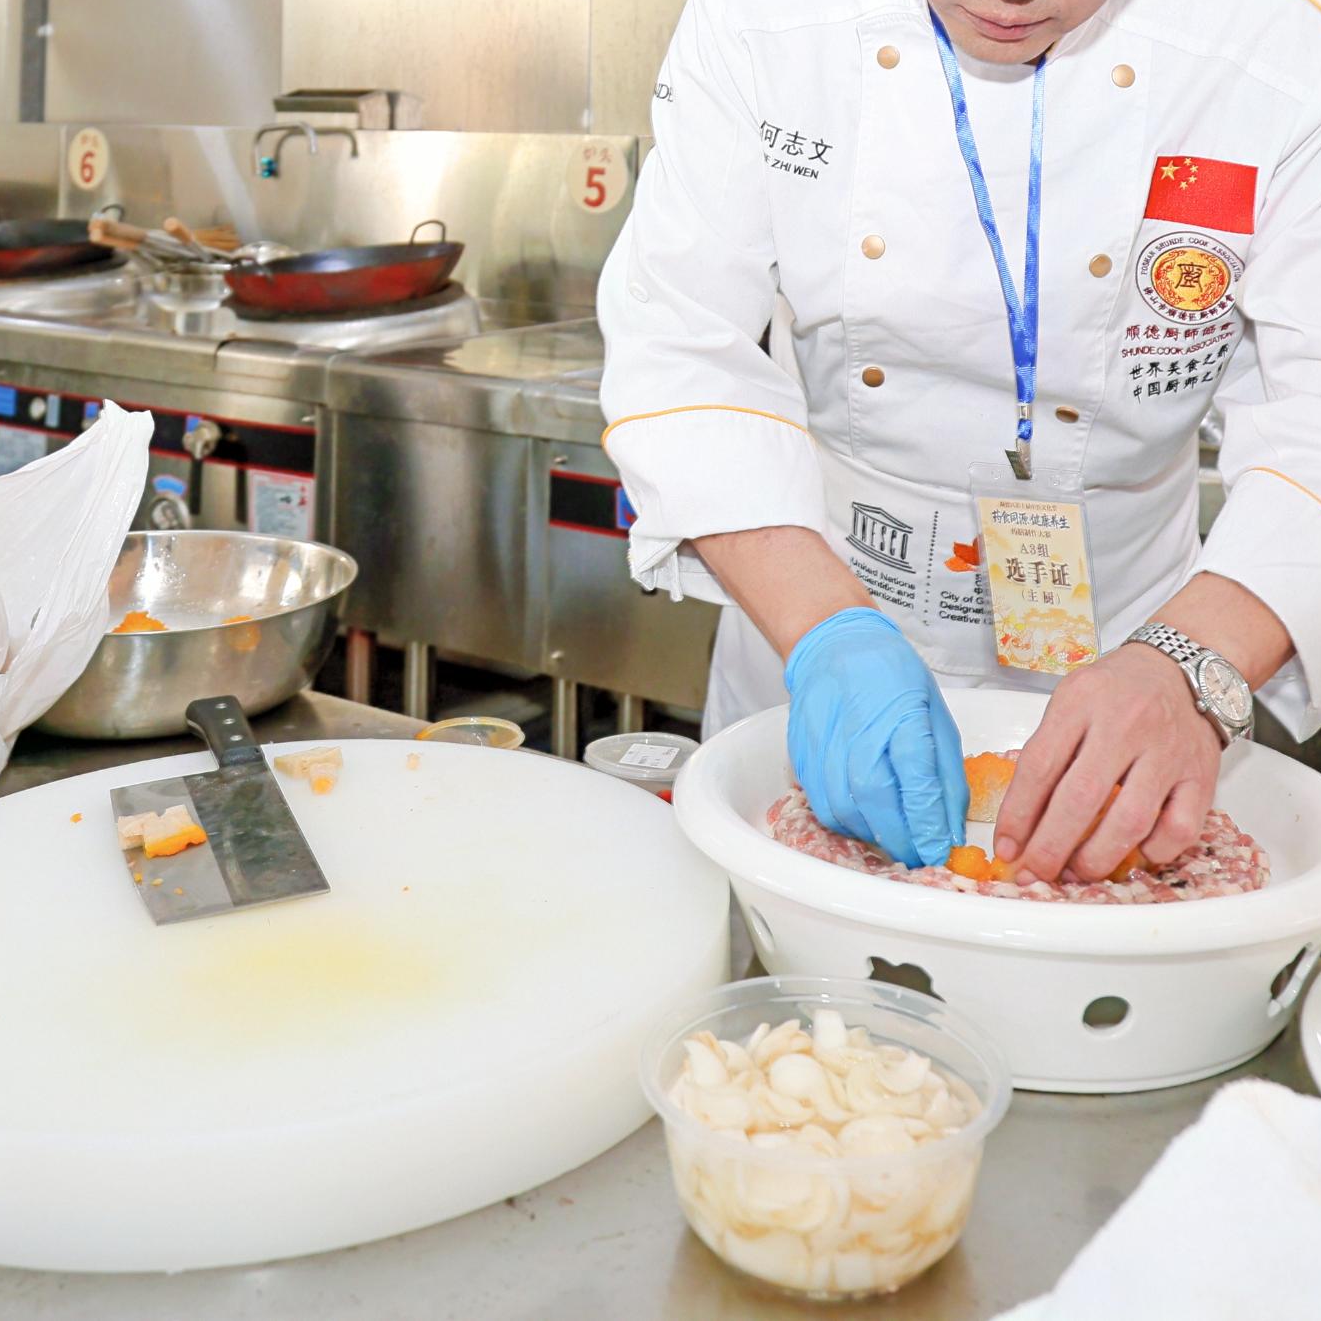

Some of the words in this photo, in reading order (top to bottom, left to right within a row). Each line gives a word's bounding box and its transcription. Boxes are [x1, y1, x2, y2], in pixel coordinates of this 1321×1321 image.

[760, 120, 833, 165] 何志文
[80, 150, 94, 183] 6
[771, 157, 792, 173] ZHI
[793, 164, 820, 180] WEN
[583, 165, 607, 209] 5
[1157, 236, 1185, 252] SHUNDE
[1188, 237, 1209, 247] COOK
[1121, 345, 1155, 359] SHUNDE
[1157, 346, 1184, 356] COOK
[1185, 330, 1236, 355] ASSOCIATION
[852, 509, 909, 560] UNESCO
[1020, 543, 1050, 558] A3组
[879, 571, 916, 591] Nations
[1006, 557, 1072, 587] 选手证
[896, 588, 916, 600] and
[940, 590, 960, 603] City
[962, 592, 974, 603] of
[938, 610, 981, 625] Creative
